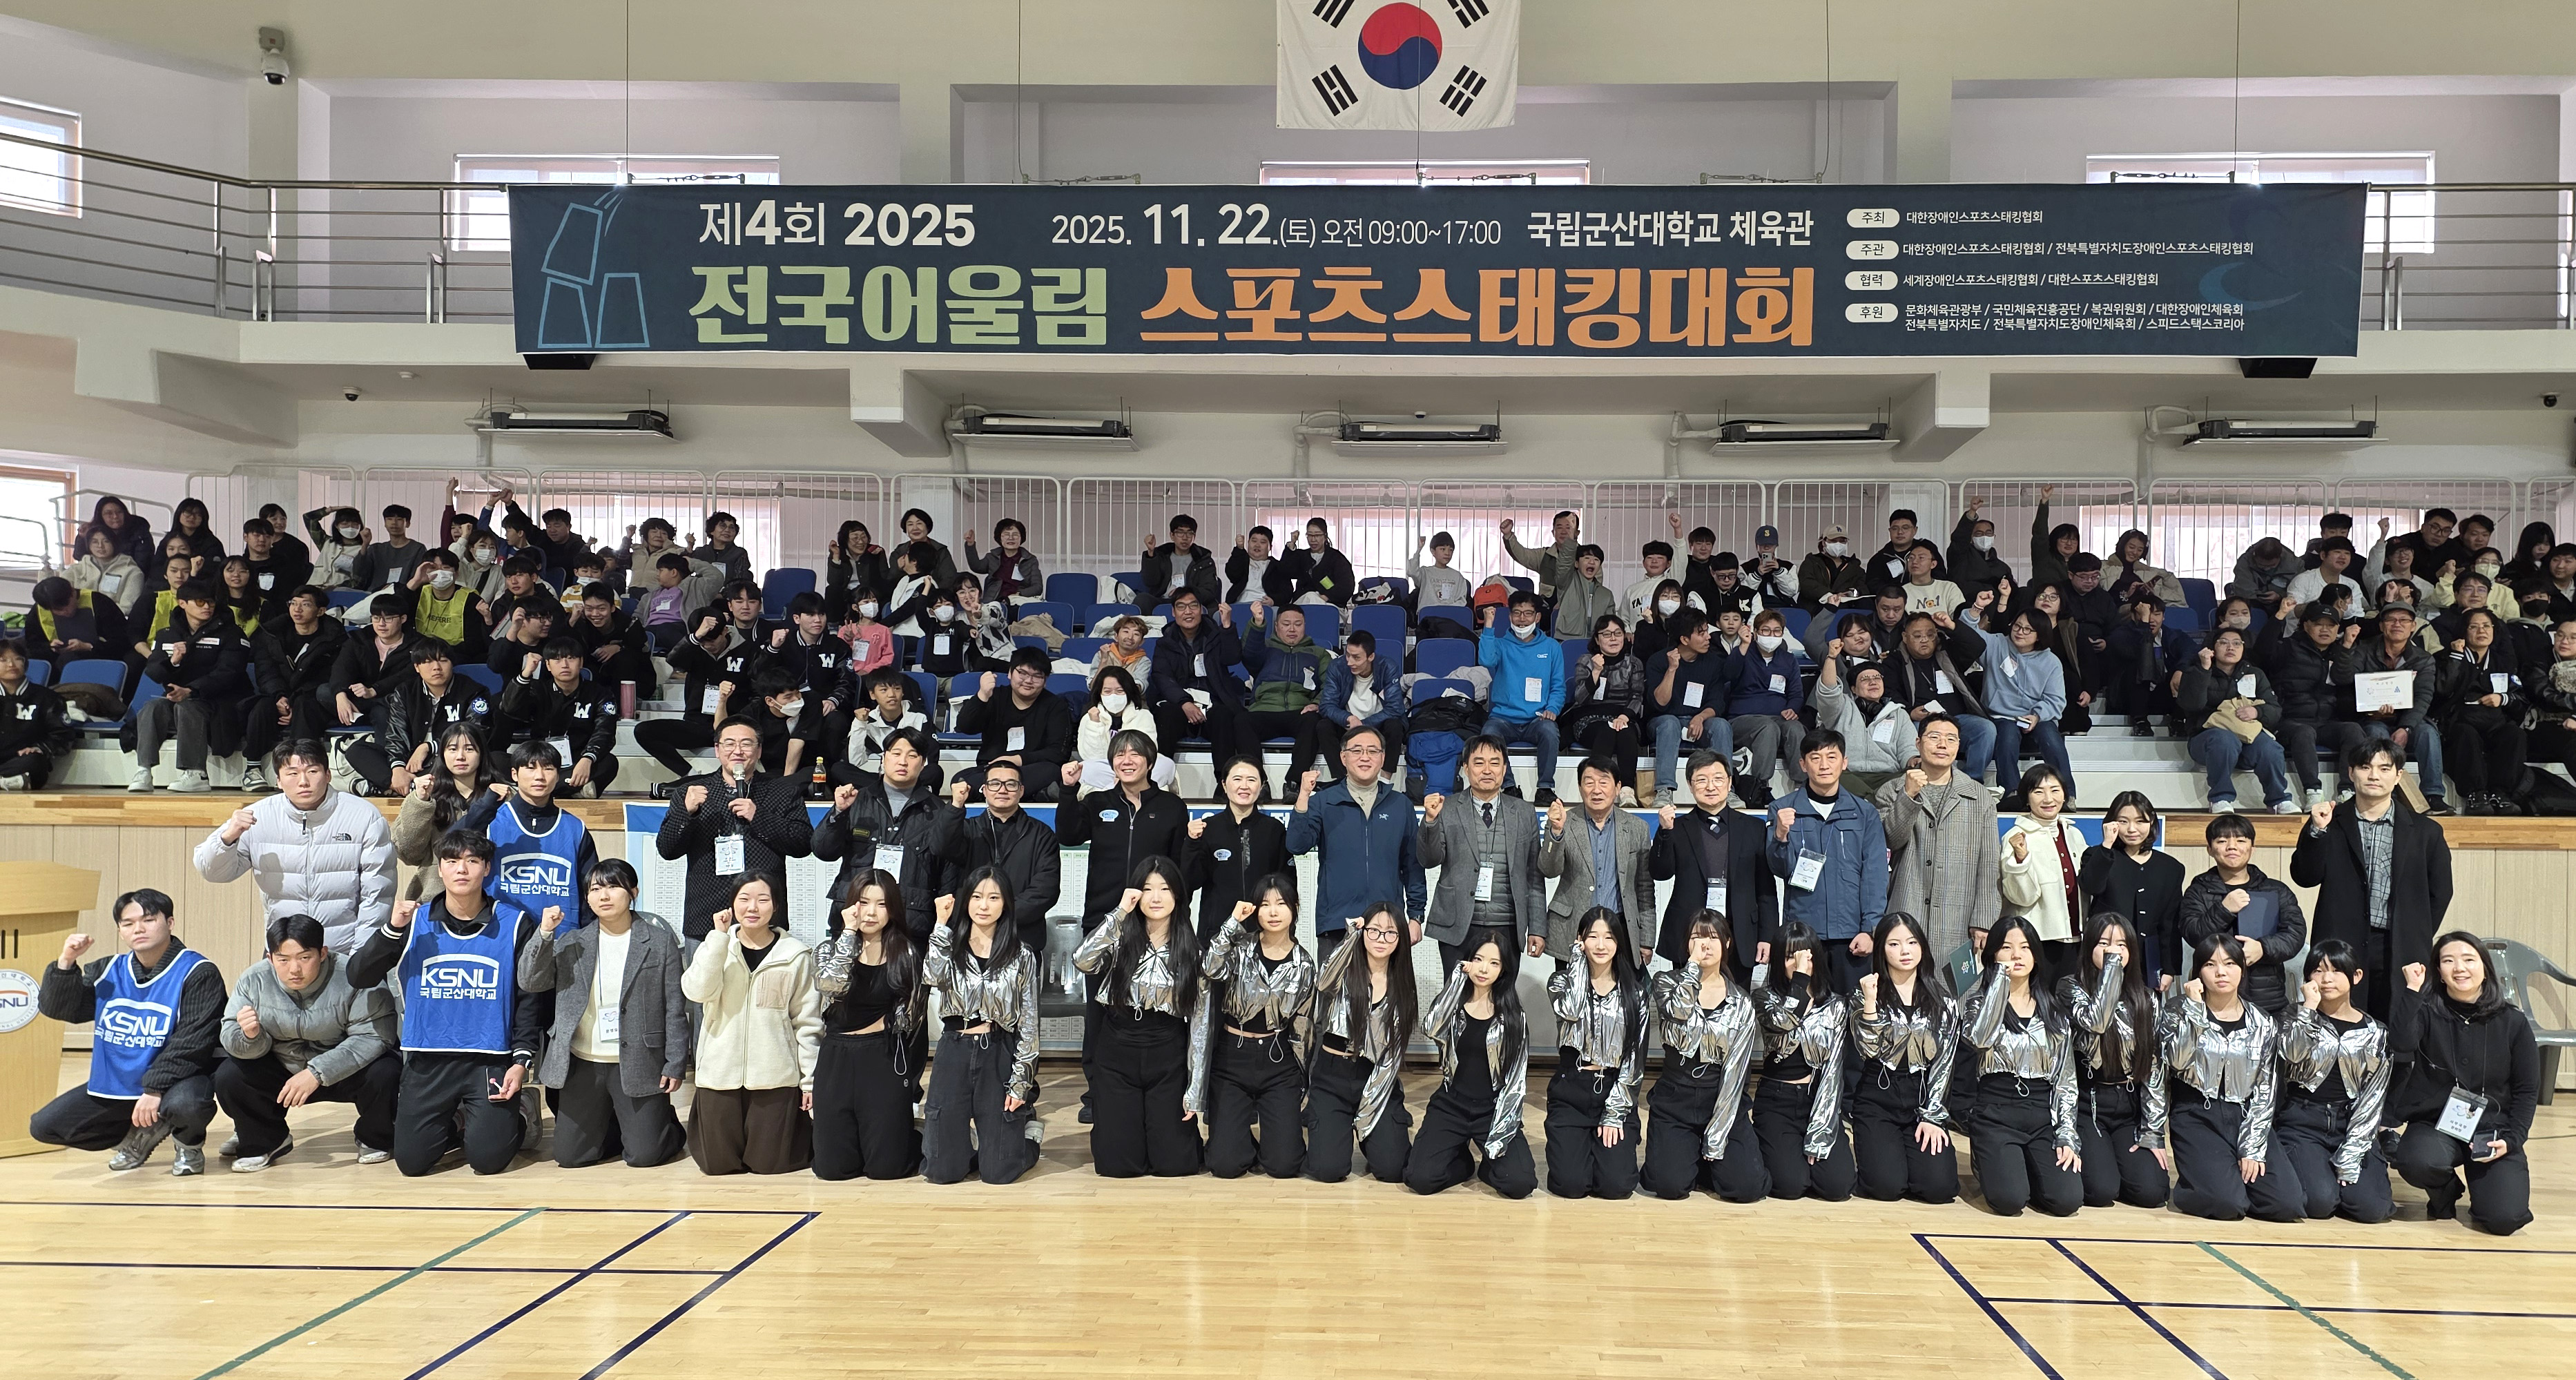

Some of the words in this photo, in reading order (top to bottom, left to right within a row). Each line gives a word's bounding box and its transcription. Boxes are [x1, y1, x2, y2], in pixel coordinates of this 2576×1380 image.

[699, 200, 824, 245] 제4회
[844, 203, 975, 246] 2025
[1052, 215, 1131, 244] 2025.
[1144, 204, 1204, 246] 11.
[1321, 218, 1362, 246] 오전
[1369, 221, 1500, 244] 09:00~17:00
[1861, 211, 1884, 224] 주최
[1906, 211, 2042, 224] 대한장애인스포츠스태킹협회
[1528, 211, 1721, 246] 국립군산대학교
[1730, 211, 1814, 246] 체육관
[1860, 244, 1884, 255] 주관
[1903, 243, 2044, 256] 대한장애인스포츠스태킹협회
[2055, 242, 2254, 255] 전북특별자치도장애인스포츠스태킹협회
[1859, 273, 1883, 286] 협력
[1903, 273, 2037, 286] 세계장애인스포츠스태킹협회
[2049, 273, 2158, 286] 대한스포츠스태킹협회
[689, 265, 1106, 344] 전국어울림
[1141, 267, 1814, 348] 스포츠스태킹대회
[1859, 306, 1883, 318] 후원
[1905, 304, 1982, 317] 문화체육관광부
[1992, 303, 2081, 315] 국민체육진흥공단
[2091, 303, 2146, 315] 복권위원회
[2156, 303, 2243, 316] 대한장애인체육회
[1905, 318, 1982, 331] 전북특별자치도
[1993, 318, 2136, 331] 전북특별자치도장애인체육회
[2146, 318, 2245, 331] 스피드스택스코리아
[1739, 598, 1751, 612] K
[726, 656, 744, 672] W
[819, 653, 835, 668] W
[16, 702, 37, 720] W
[445, 703, 460, 722] W
[573, 701, 592, 719] W
[501, 864, 570, 886] KSNU
[500, 882, 570, 897] 국립군산대학교
[421, 967, 498, 988] KSNU
[420, 987, 497, 1000] 국립군산대학교
[99, 1007, 171, 1036] KSNU
[95, 1026, 166, 1048] 국립군산대학교
